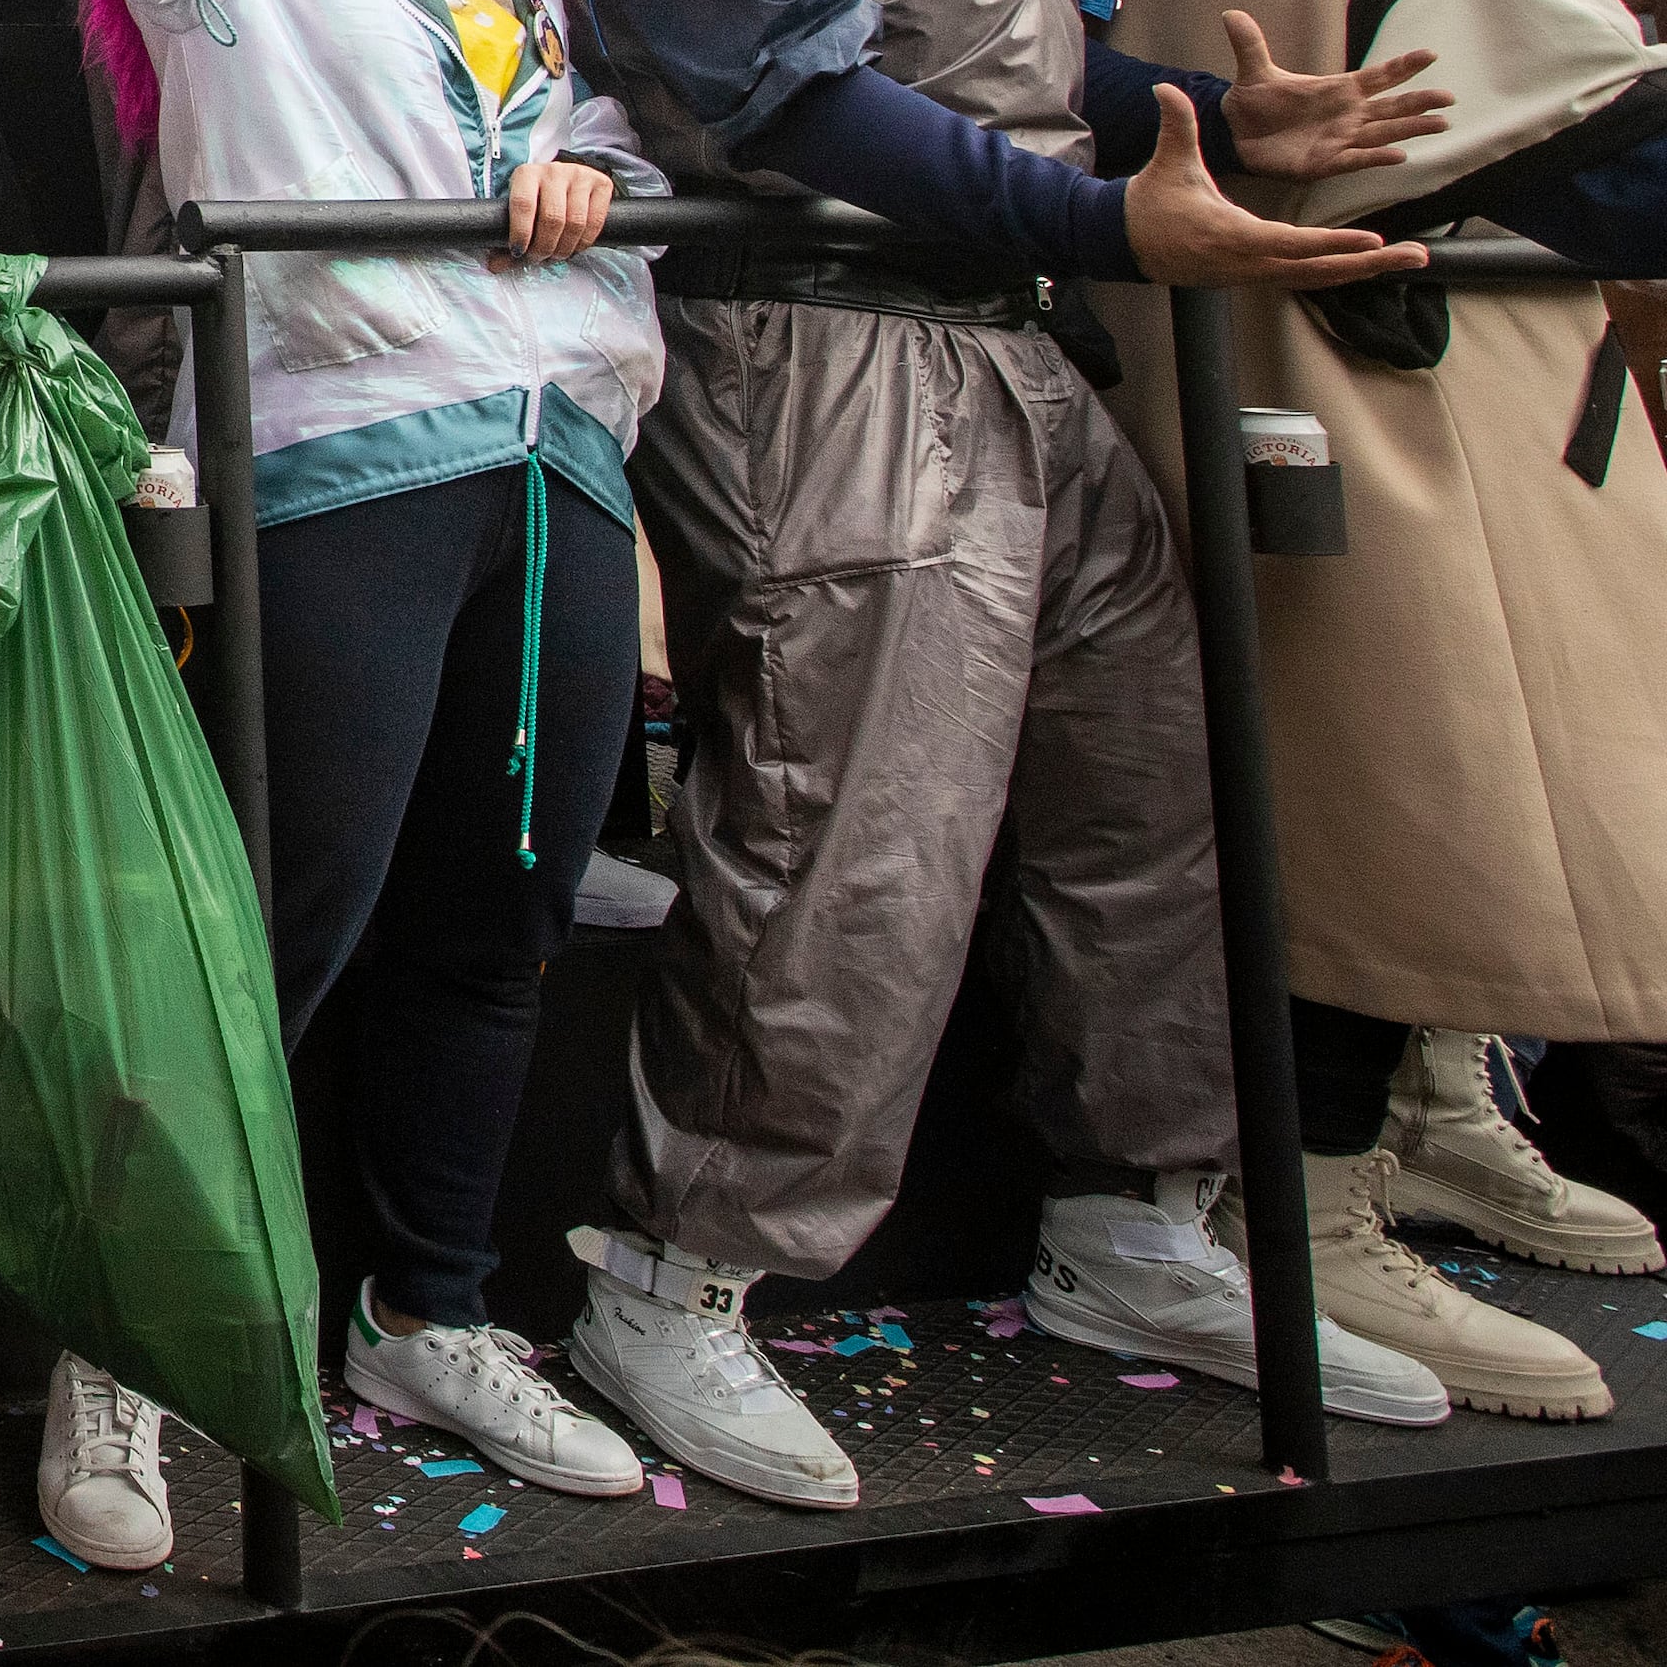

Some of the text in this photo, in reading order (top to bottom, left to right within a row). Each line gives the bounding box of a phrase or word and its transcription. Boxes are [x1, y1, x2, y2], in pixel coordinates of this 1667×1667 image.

[1245, 442, 1316, 465] ICTORIA
[136, 483, 182, 509] TORIA
[699, 1283, 734, 1314] 33
[613, 1307, 647, 1336] Fashion
